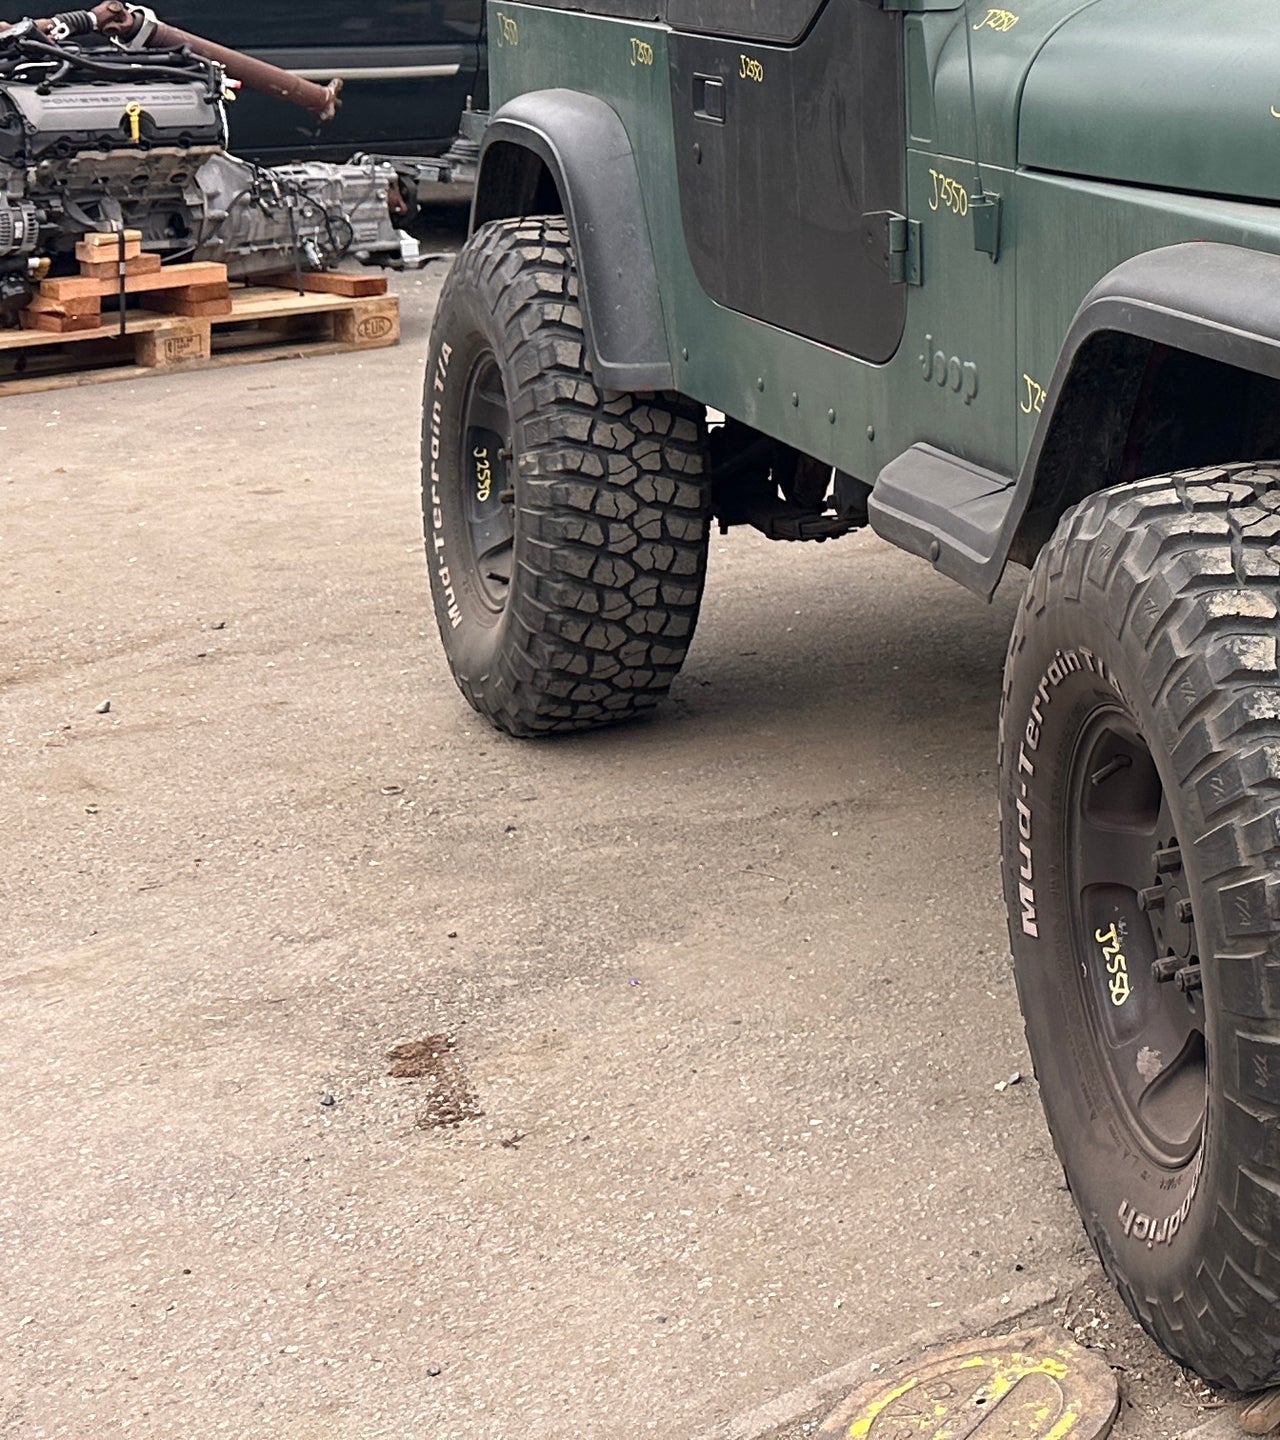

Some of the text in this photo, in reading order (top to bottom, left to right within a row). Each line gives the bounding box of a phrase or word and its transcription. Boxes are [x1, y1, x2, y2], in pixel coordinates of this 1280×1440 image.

[929, 168, 968, 216] J2550
[364, 318, 386, 334] EUR
[472, 447, 492, 502] J2550
[1016, 648, 1081, 939] Mud-Terrain
[1094, 921, 1131, 1006] J2550
